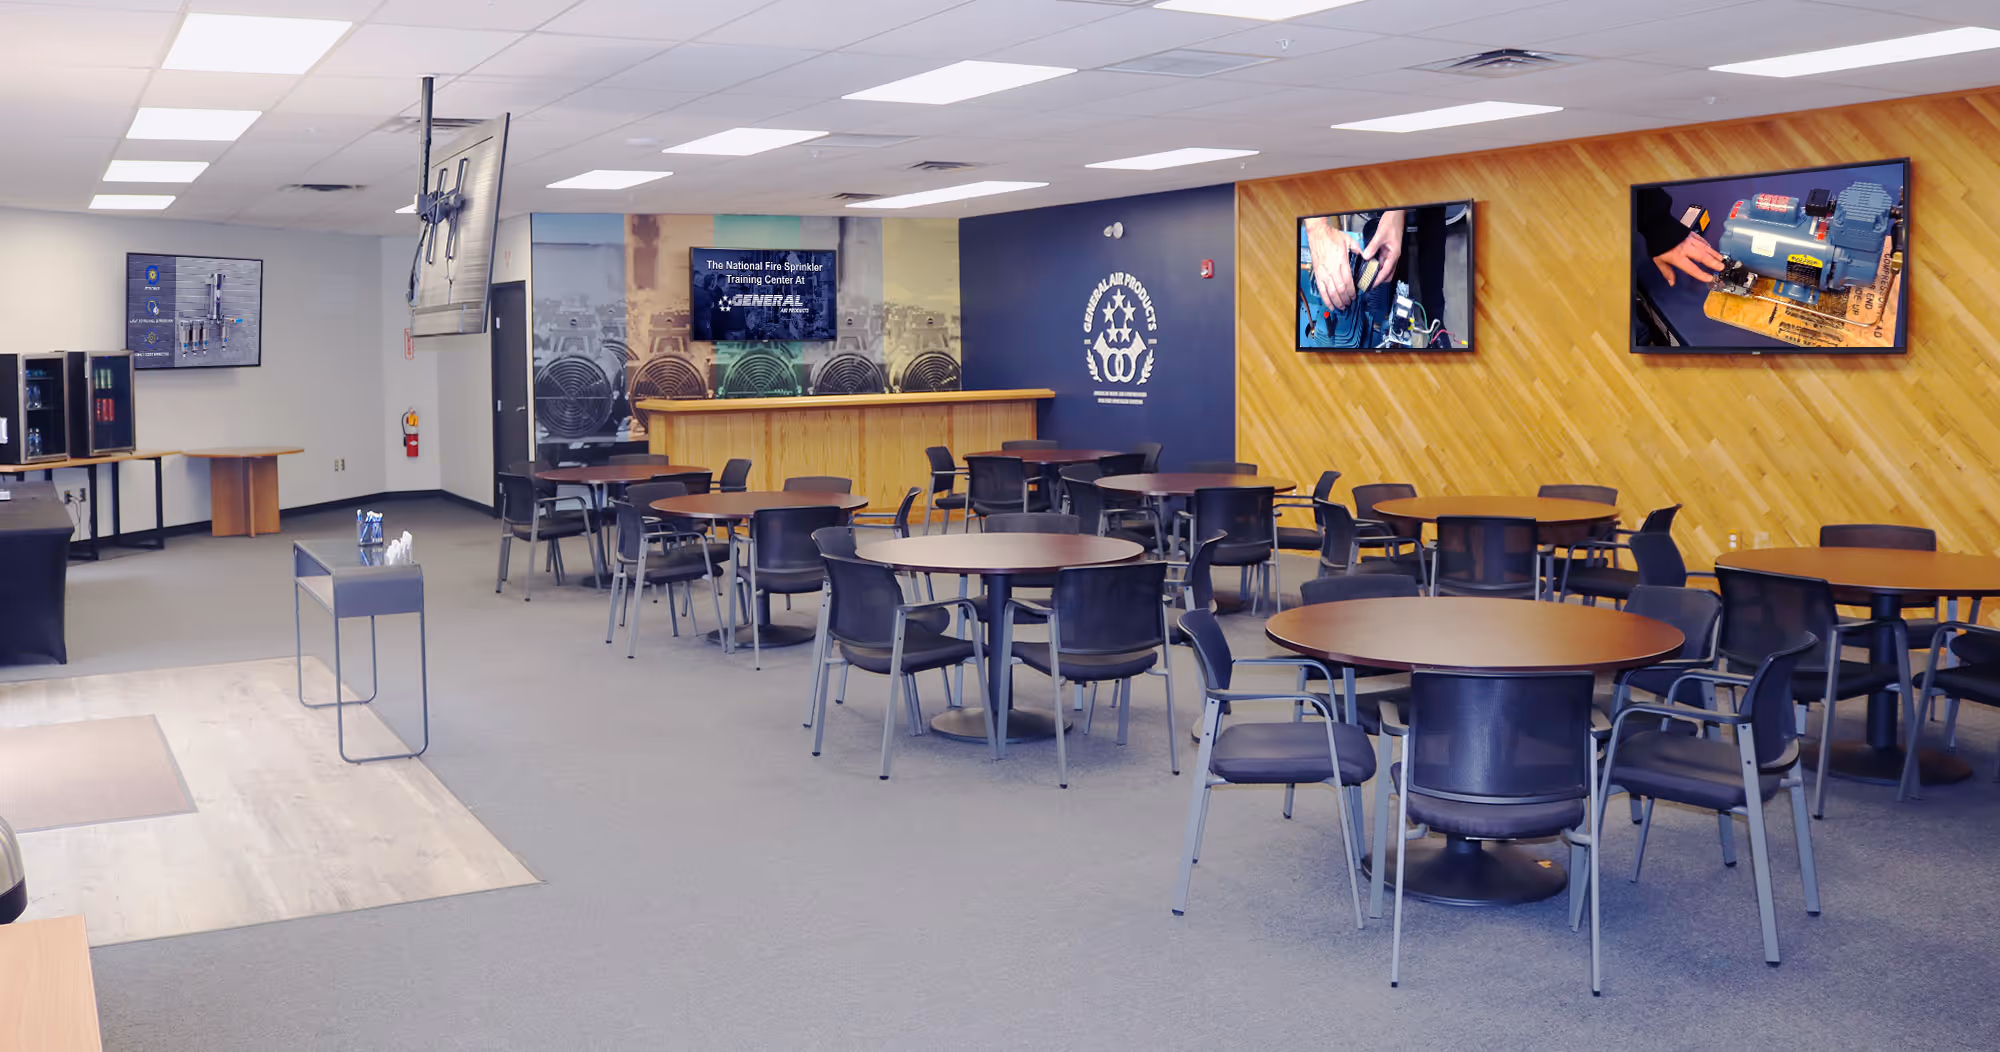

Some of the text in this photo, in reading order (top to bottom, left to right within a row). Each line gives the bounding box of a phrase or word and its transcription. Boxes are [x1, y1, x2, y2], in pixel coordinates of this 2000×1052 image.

[706, 260, 823, 273] The National Fire Sprinkler
[726, 274, 805, 285] Training Center At
[733, 294, 803, 307] GENERAL
[1083, 271, 1157, 333] GENERAL AIR PRODUCTS
[1864, 292, 1875, 310] END
